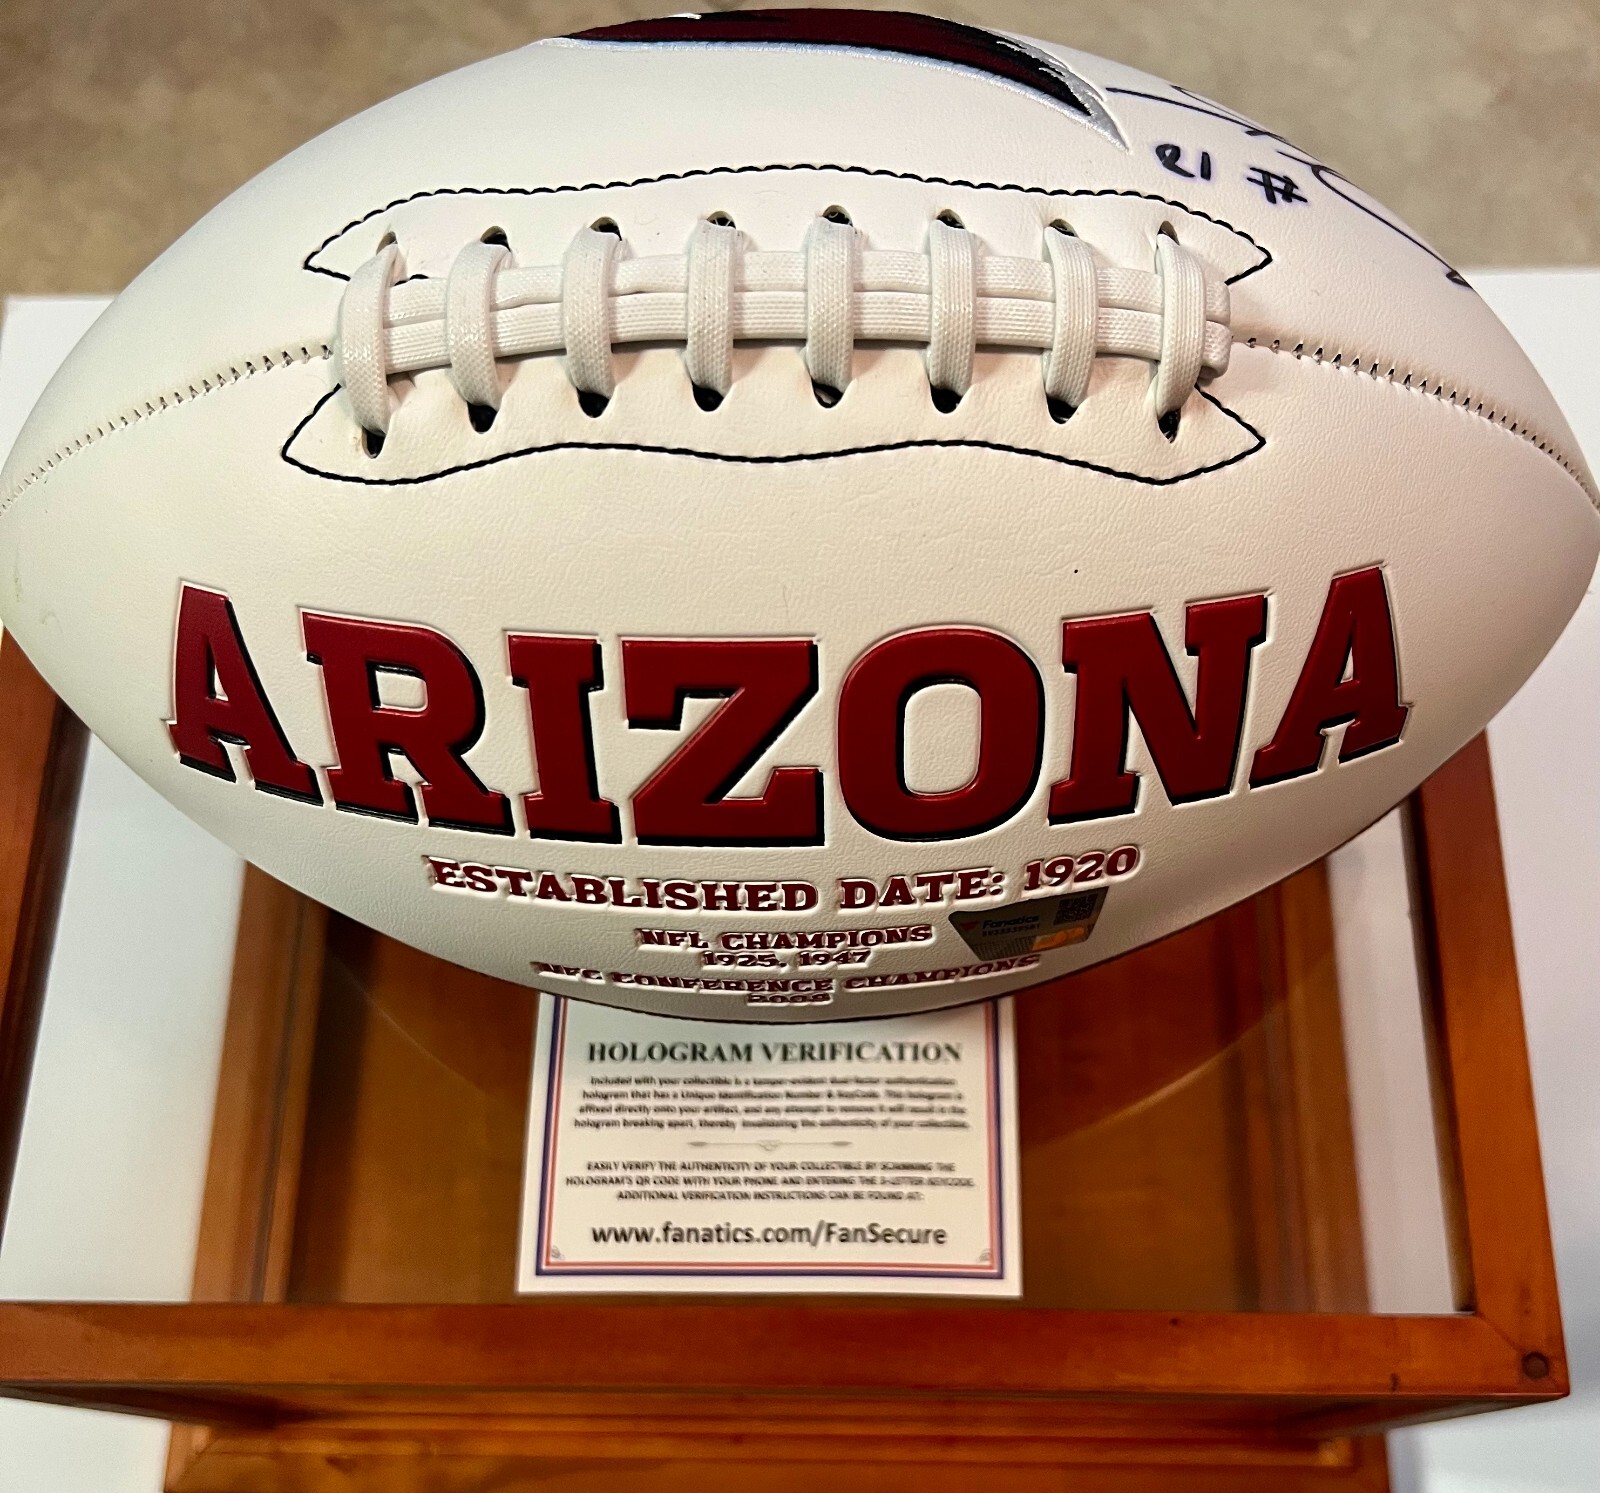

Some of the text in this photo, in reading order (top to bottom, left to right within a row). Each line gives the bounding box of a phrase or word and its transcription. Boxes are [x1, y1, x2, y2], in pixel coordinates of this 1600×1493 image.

[165, 566, 1409, 848] ARIZONA
[428, 844, 1138, 912] ESTABLISHED DATE: 1920
[982, 914, 1040, 930] Fanatics
[637, 924, 933, 950] NFL CHAMPIONS
[800, 950, 870, 966] 1947
[532, 954, 1041, 992] NFC CONFERENCE CHAMPIONS
[587, 1040, 963, 1064] HOLOGRAM VERIFICATION
[622, 1161, 656, 1170] VERIFY
[682, 1176, 710, 1185] WITH
[712, 1176, 742, 1185] YOUR
[591, 1219, 948, 1248] www.fanatics.com/FanSecure
